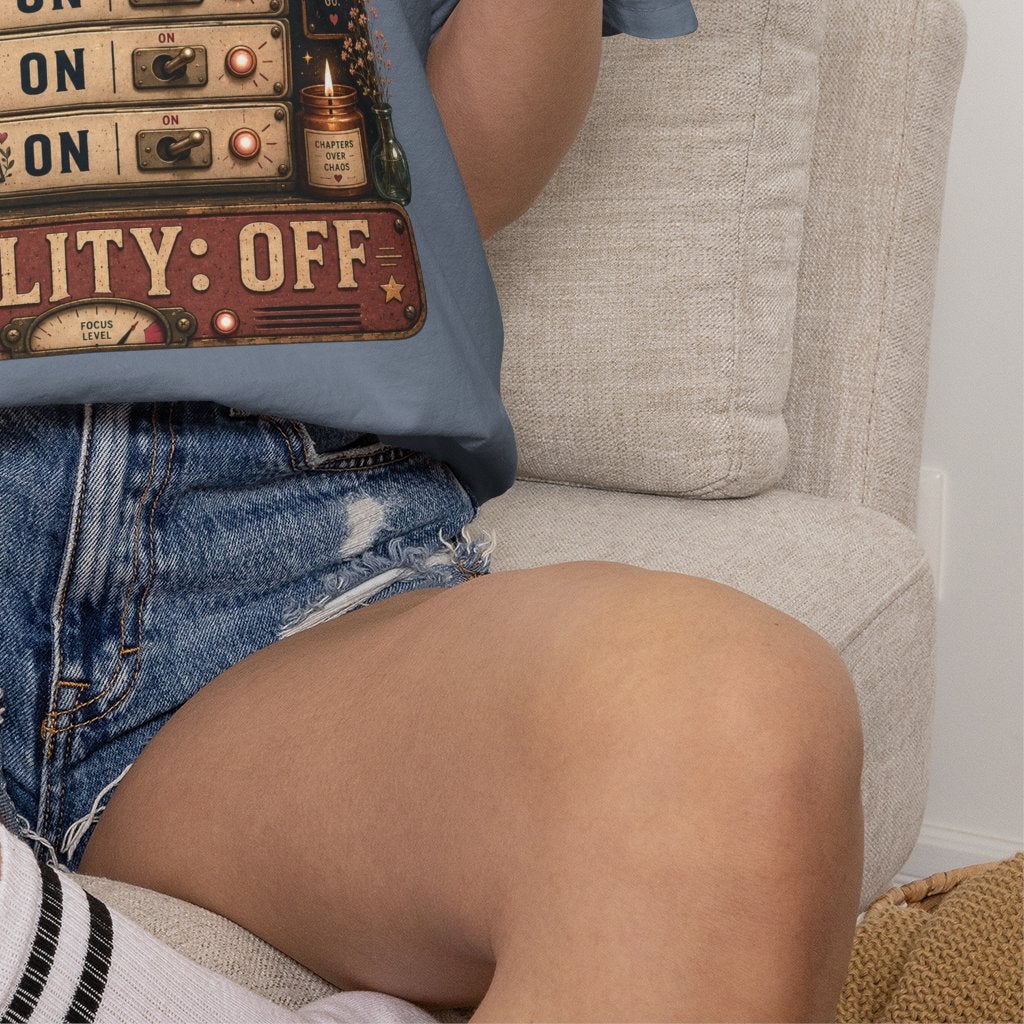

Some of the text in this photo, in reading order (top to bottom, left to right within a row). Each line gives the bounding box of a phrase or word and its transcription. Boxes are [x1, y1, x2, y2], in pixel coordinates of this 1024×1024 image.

[157, 32, 176, 44] ON
[20, 47, 86, 96] ON
[162, 114, 179, 126] ON
[314, 139, 354, 149] CHAPTERS
[24, 129, 90, 177] ON
[325, 151, 346, 161] OVER
[323, 162, 351, 172] CHAOS
[238, 219, 371, 293] OFF
[80, 320, 114, 331] FOCUS
[82, 330, 112, 341] LEVEL
